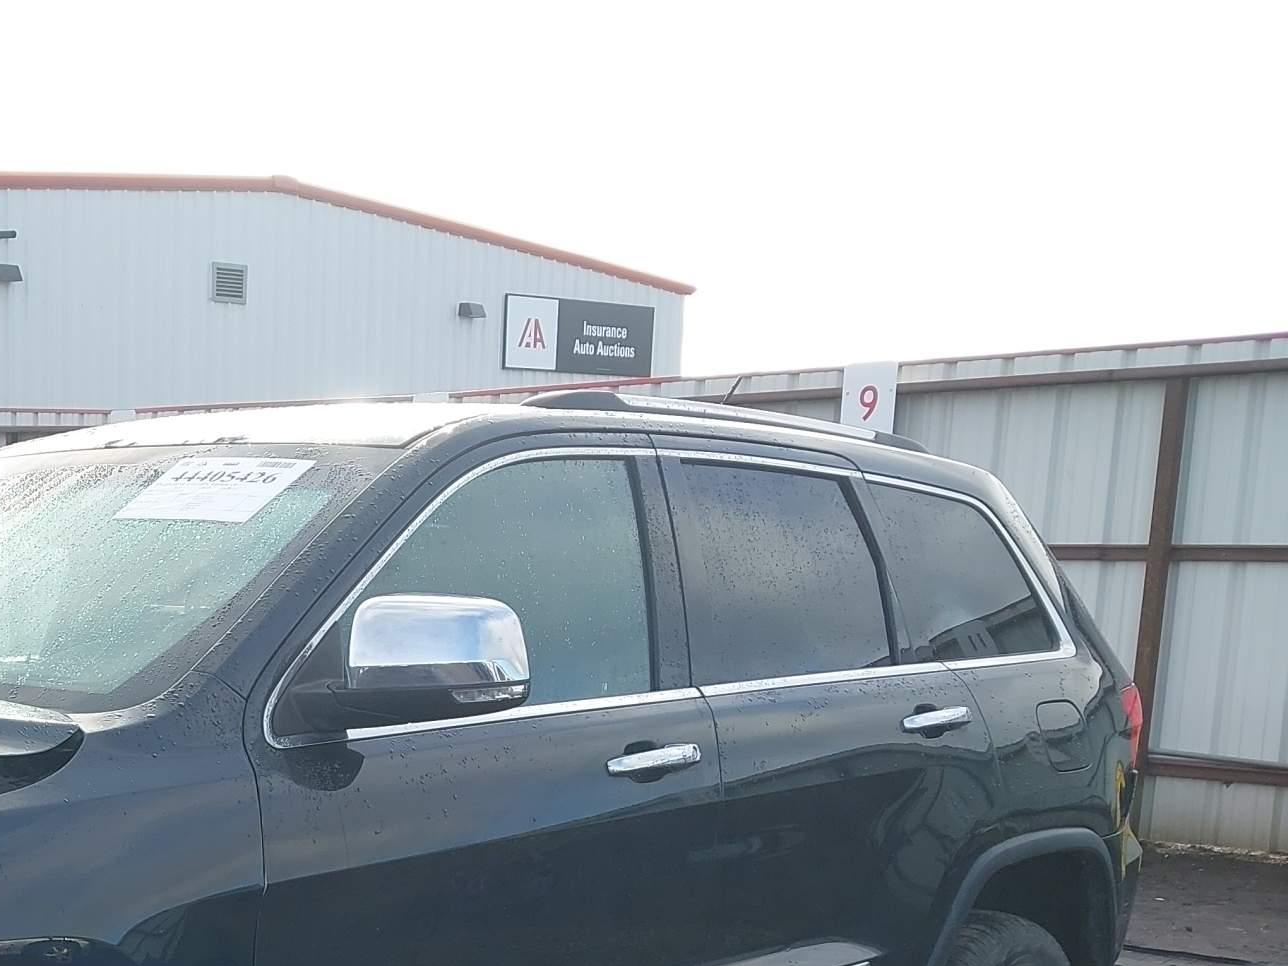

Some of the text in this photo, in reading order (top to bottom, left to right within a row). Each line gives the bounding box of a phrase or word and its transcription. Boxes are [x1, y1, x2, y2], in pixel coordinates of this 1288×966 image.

[583, 320, 628, 339] Insurance
[573, 339, 636, 358] Auto Auctions
[859, 385, 879, 422] 9
[171, 470, 280, 484] 44405426
